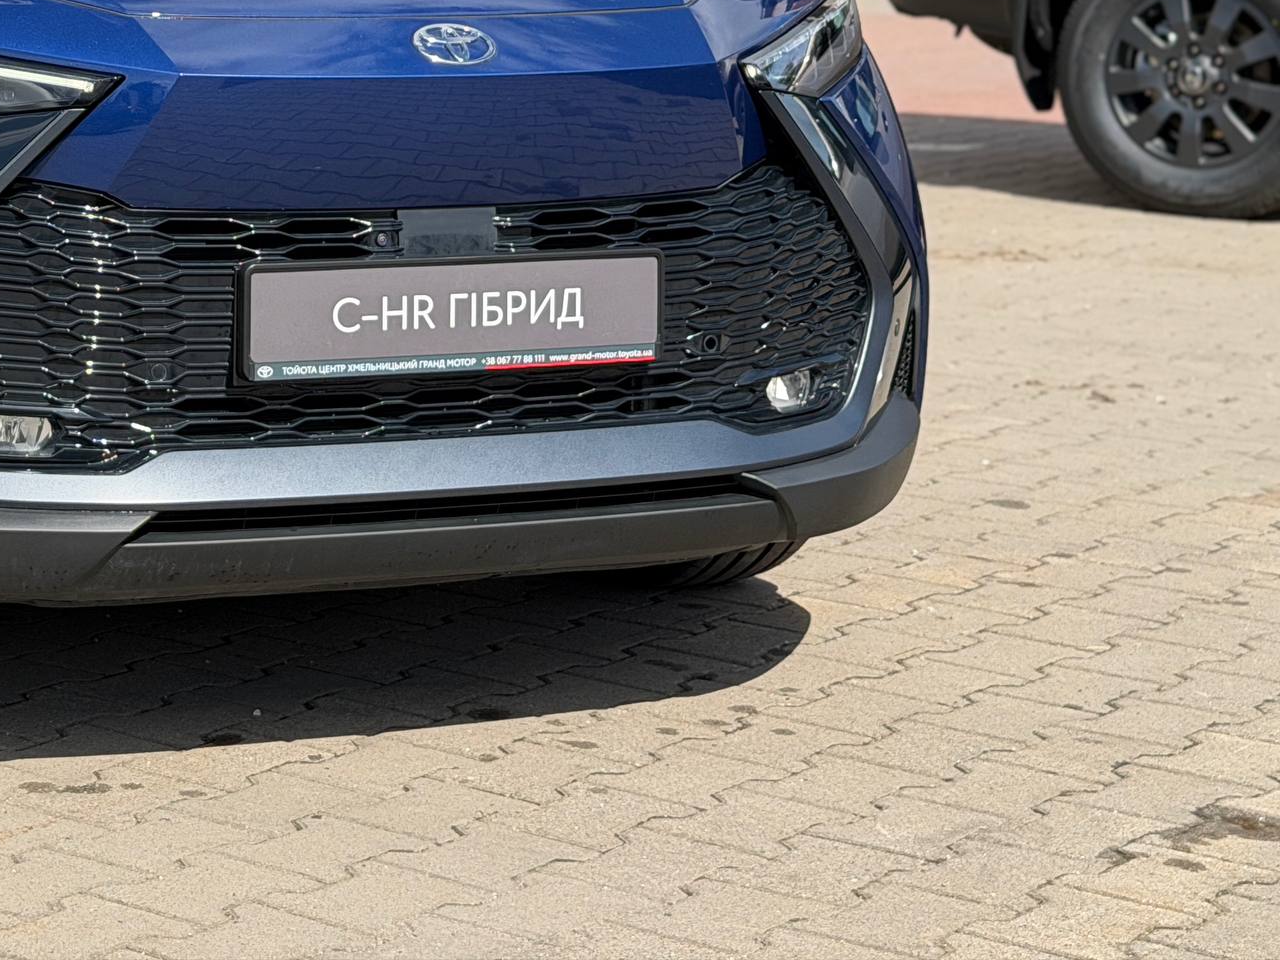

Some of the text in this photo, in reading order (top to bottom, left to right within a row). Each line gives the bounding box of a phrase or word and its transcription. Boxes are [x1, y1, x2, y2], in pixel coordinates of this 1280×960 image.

[331, 286, 585, 334] C-HR ГІБРИД
[282, 364, 317, 376] ТОЙОТА
[318, 363, 346, 375] ЦЕНТР
[419, 359, 446, 370] ГРАНД
[446, 357, 477, 368] МОТОР
